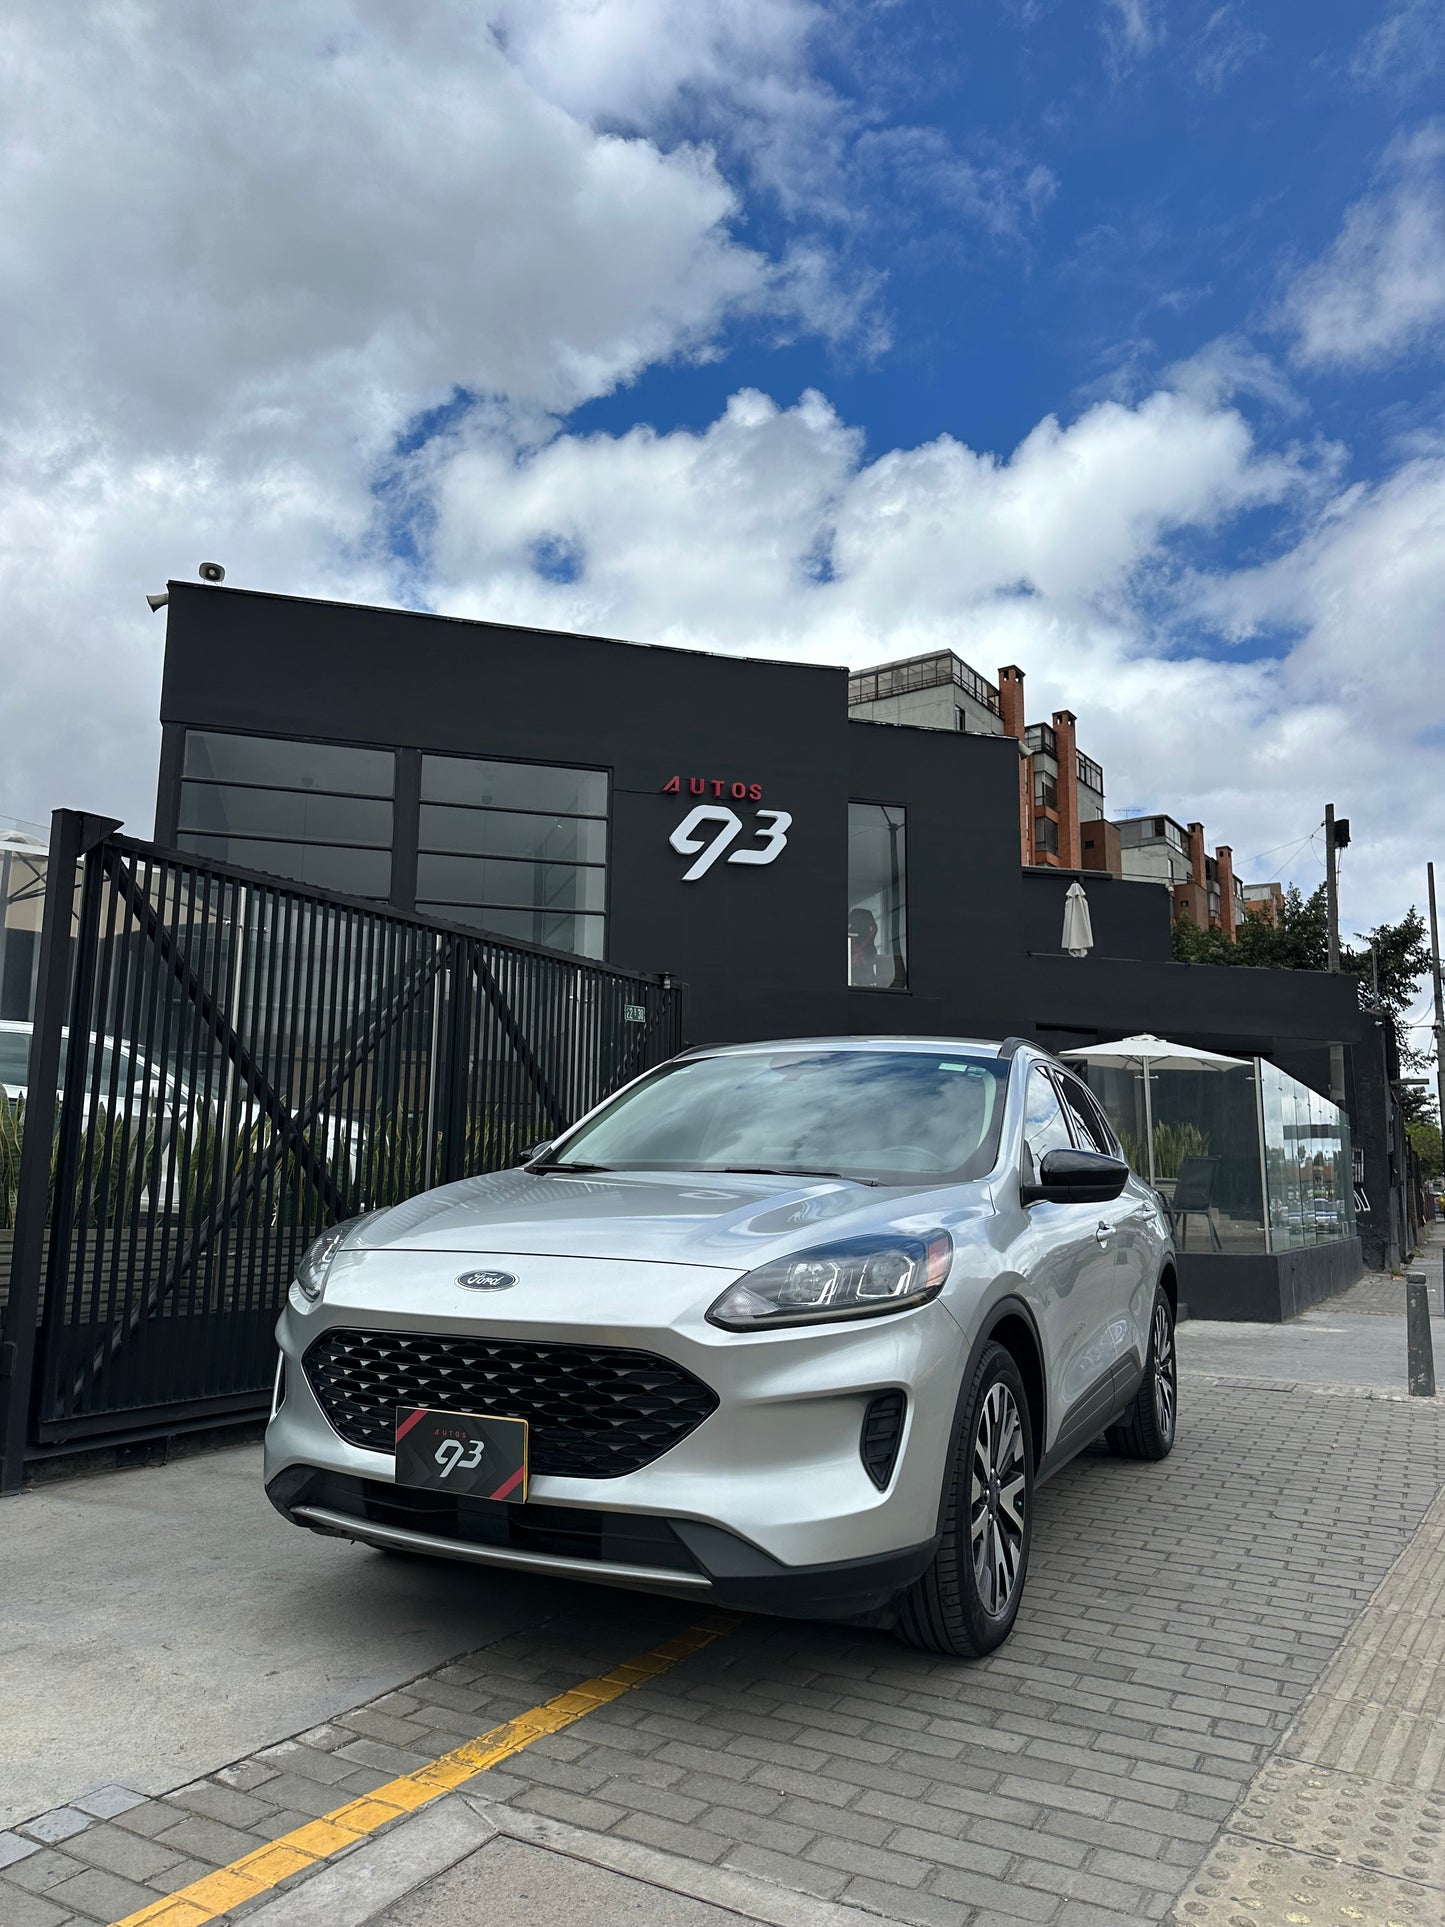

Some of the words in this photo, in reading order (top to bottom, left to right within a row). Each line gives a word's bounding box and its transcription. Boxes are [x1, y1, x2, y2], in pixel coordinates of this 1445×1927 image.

[662, 775, 762, 800] AUTOS
[668, 804, 793, 881] 93
[467, 1271, 504, 1286] Ford
[433, 1428, 467, 1439] AUTOS
[434, 1438, 485, 1478] 93
